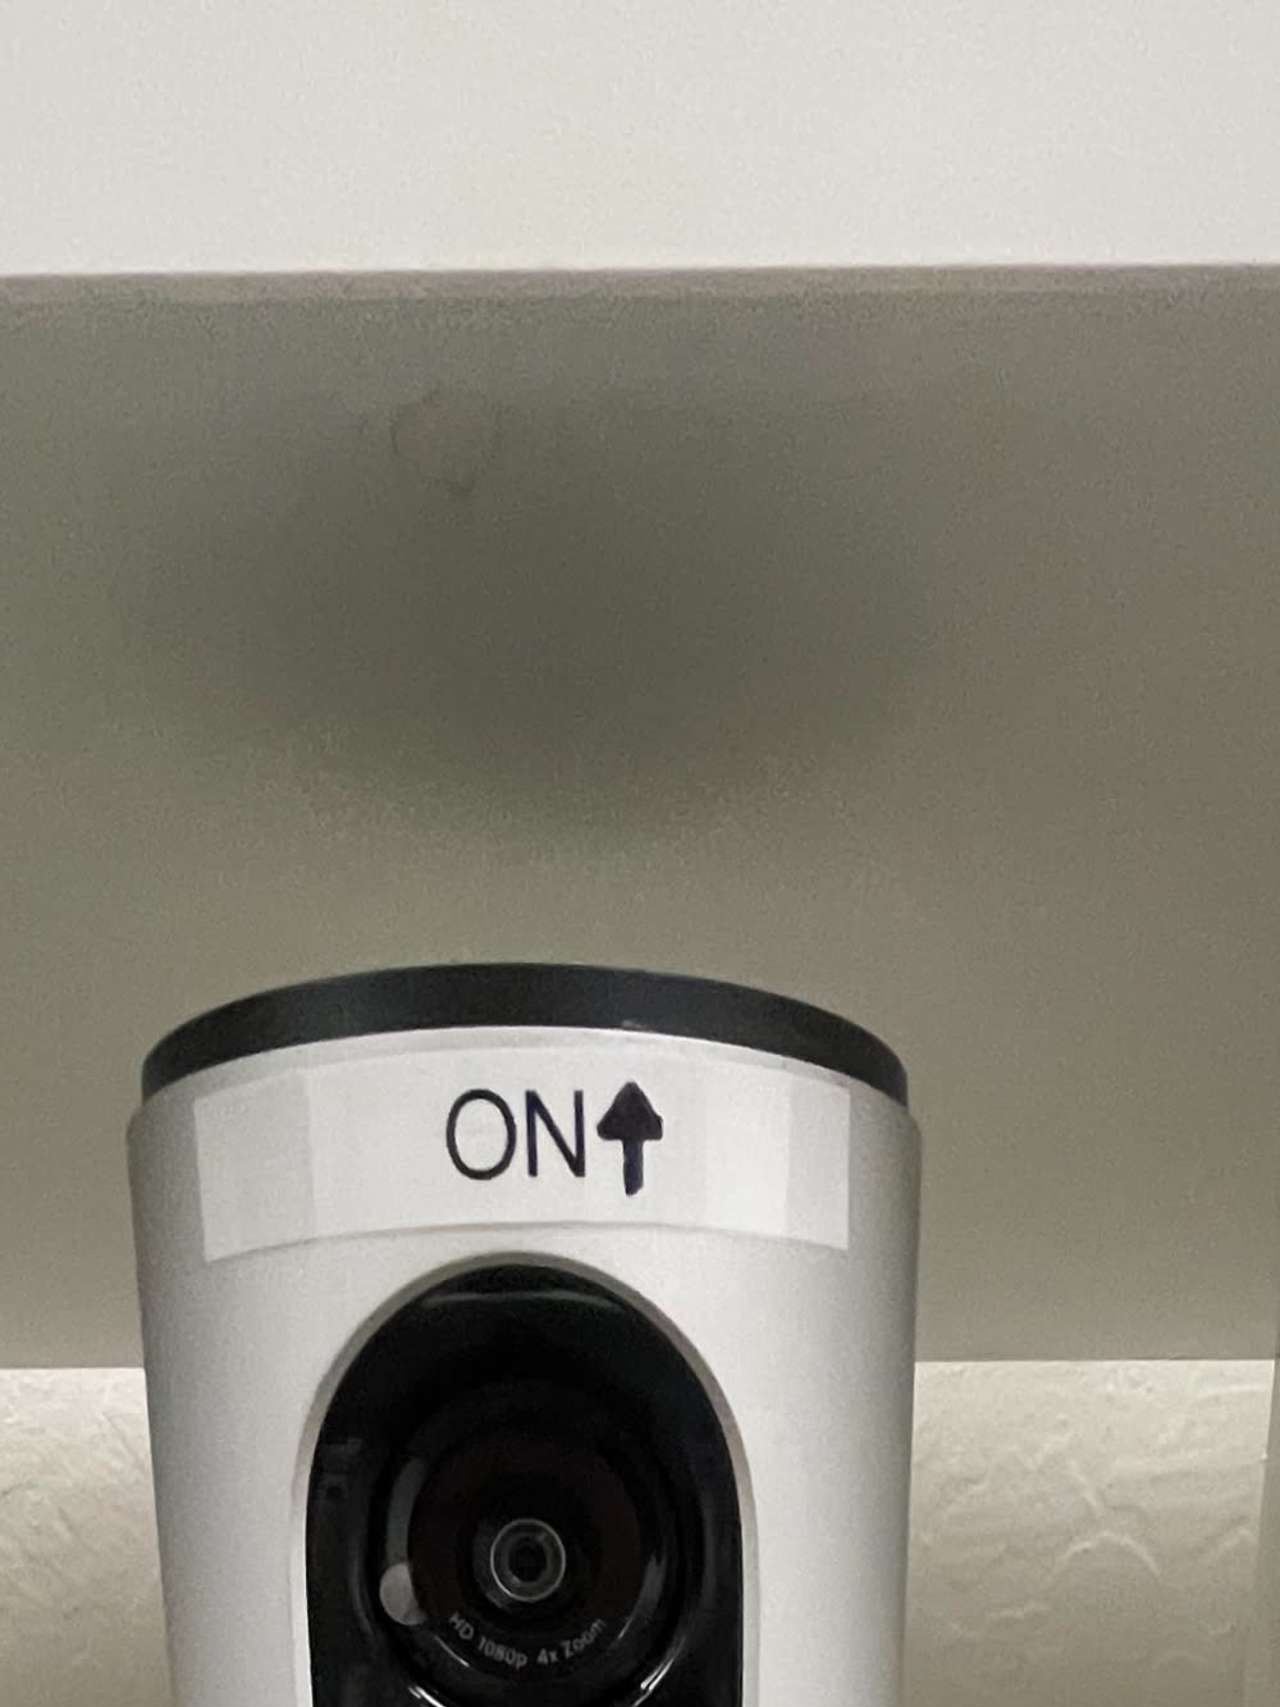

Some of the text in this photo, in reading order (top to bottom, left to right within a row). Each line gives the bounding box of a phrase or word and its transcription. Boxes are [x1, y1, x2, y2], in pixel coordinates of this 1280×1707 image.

[446, 1088, 586, 1181] ON
[448, 1612, 608, 1670] HD 1080p 4x Zoom
